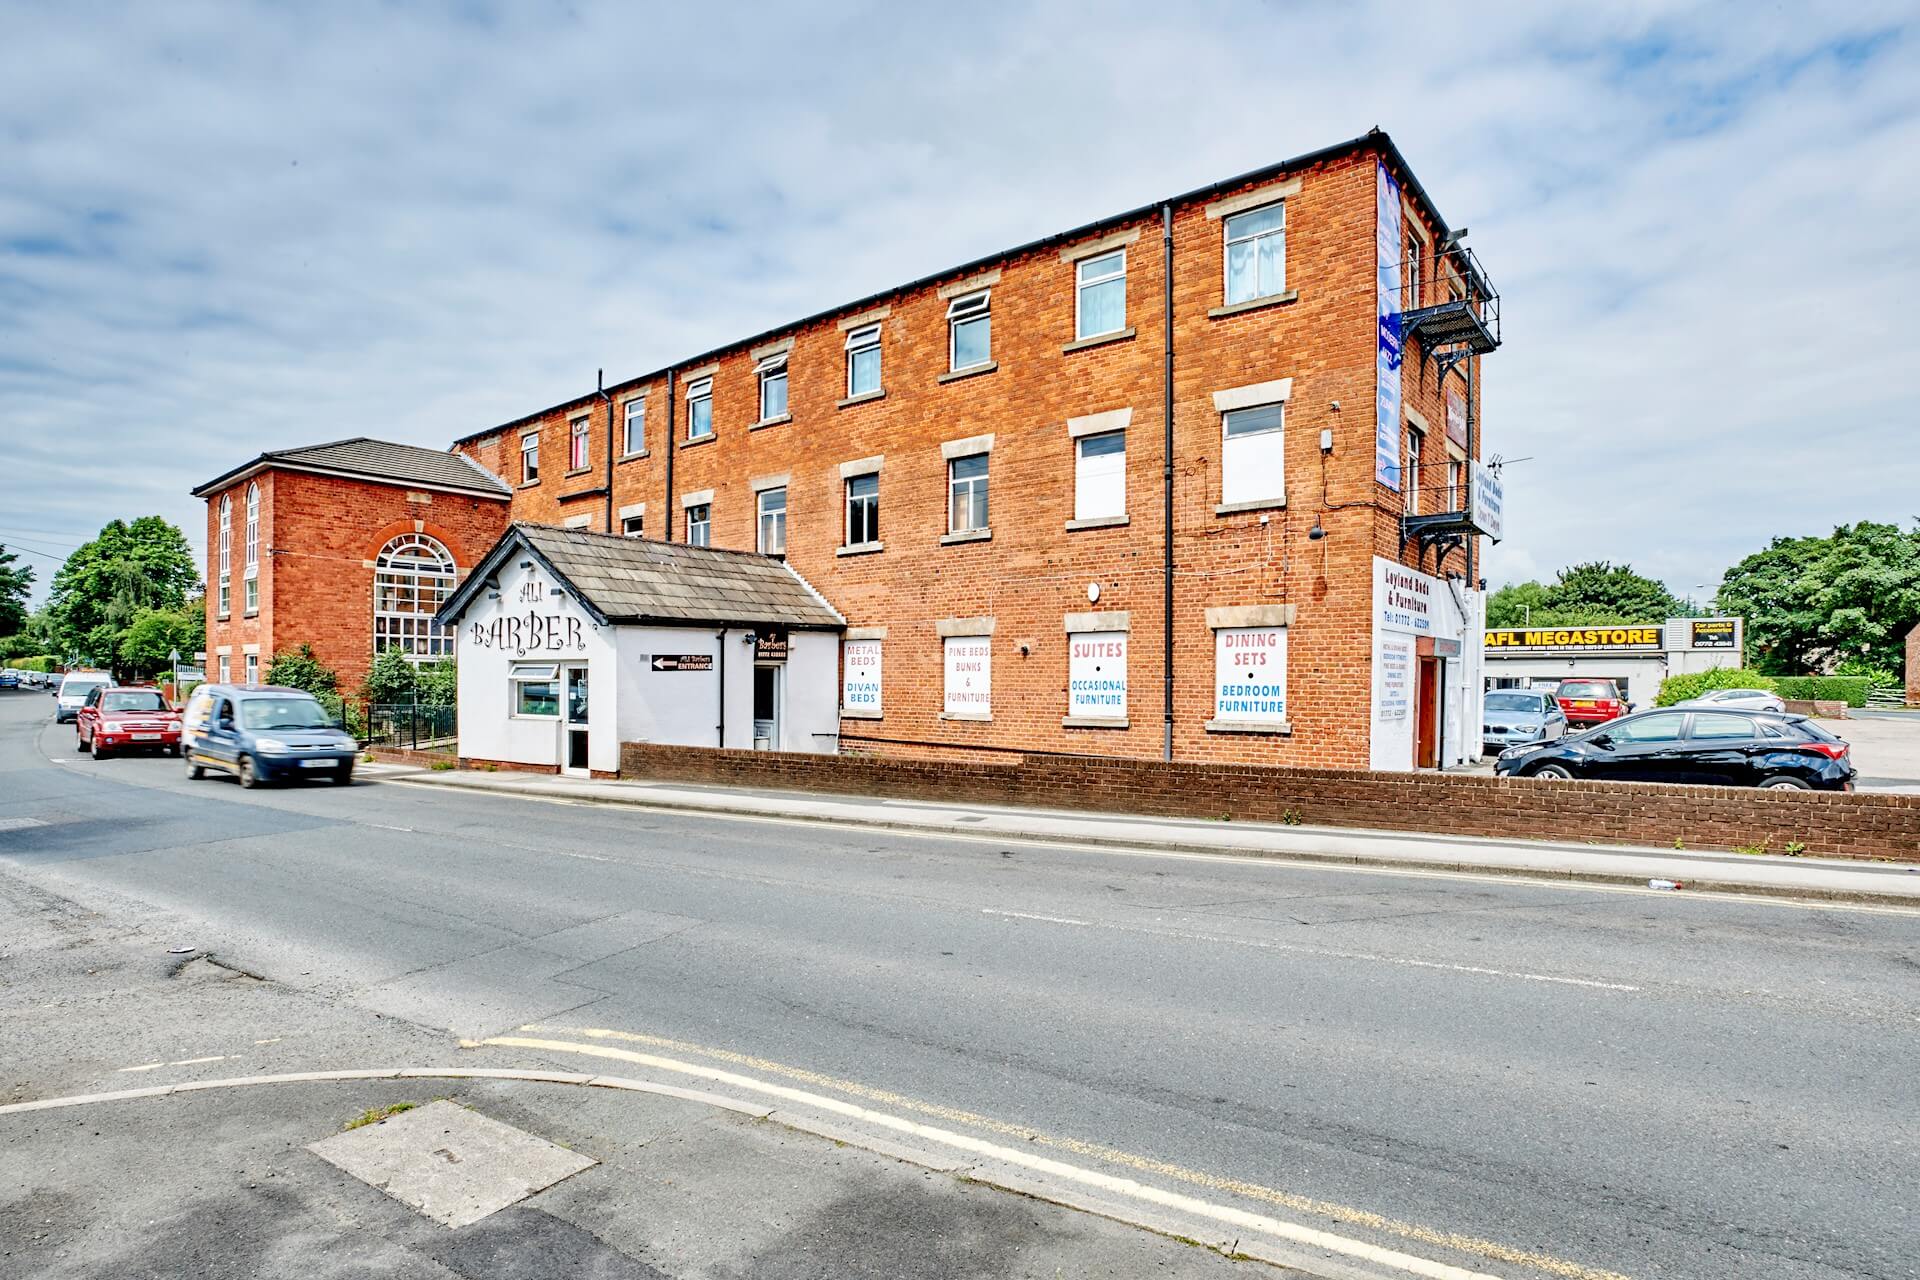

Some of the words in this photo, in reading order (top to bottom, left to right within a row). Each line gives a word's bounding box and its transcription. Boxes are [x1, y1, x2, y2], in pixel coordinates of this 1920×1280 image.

[1385, 567, 1413, 591] Leyland
[1415, 577, 1429, 596] Beds
[519, 581, 543, 603] ALI
[1395, 592, 1427, 614] Furniture
[1395, 613, 1410, 626] 01772
[1225, 633, 1277, 648] DINING
[1485, 632, 1520, 646] AFL
[1525, 629, 1658, 646] MEGASTORE
[758, 638, 787, 650] Barbers
[1074, 642, 1122, 658] SUITES
[848, 646, 879, 655] METAL
[949, 647, 966, 656] PINE
[969, 647, 989, 656] BEDS
[851, 657, 876, 666] BEDS
[1234, 652, 1267, 666] SETS
[956, 662, 981, 672] BUNKS
[847, 683, 879, 692] DIVAN
[965, 677, 971, 687] &
[1072, 679, 1126, 691] OCCASIONAL
[1222, 684, 1280, 697] BEDROOM
[850, 694, 876, 703] BEDS
[948, 693, 990, 703] FURNITURE
[1075, 693, 1122, 705] FURNITURE
[1219, 700, 1284, 713] FURNITURE
